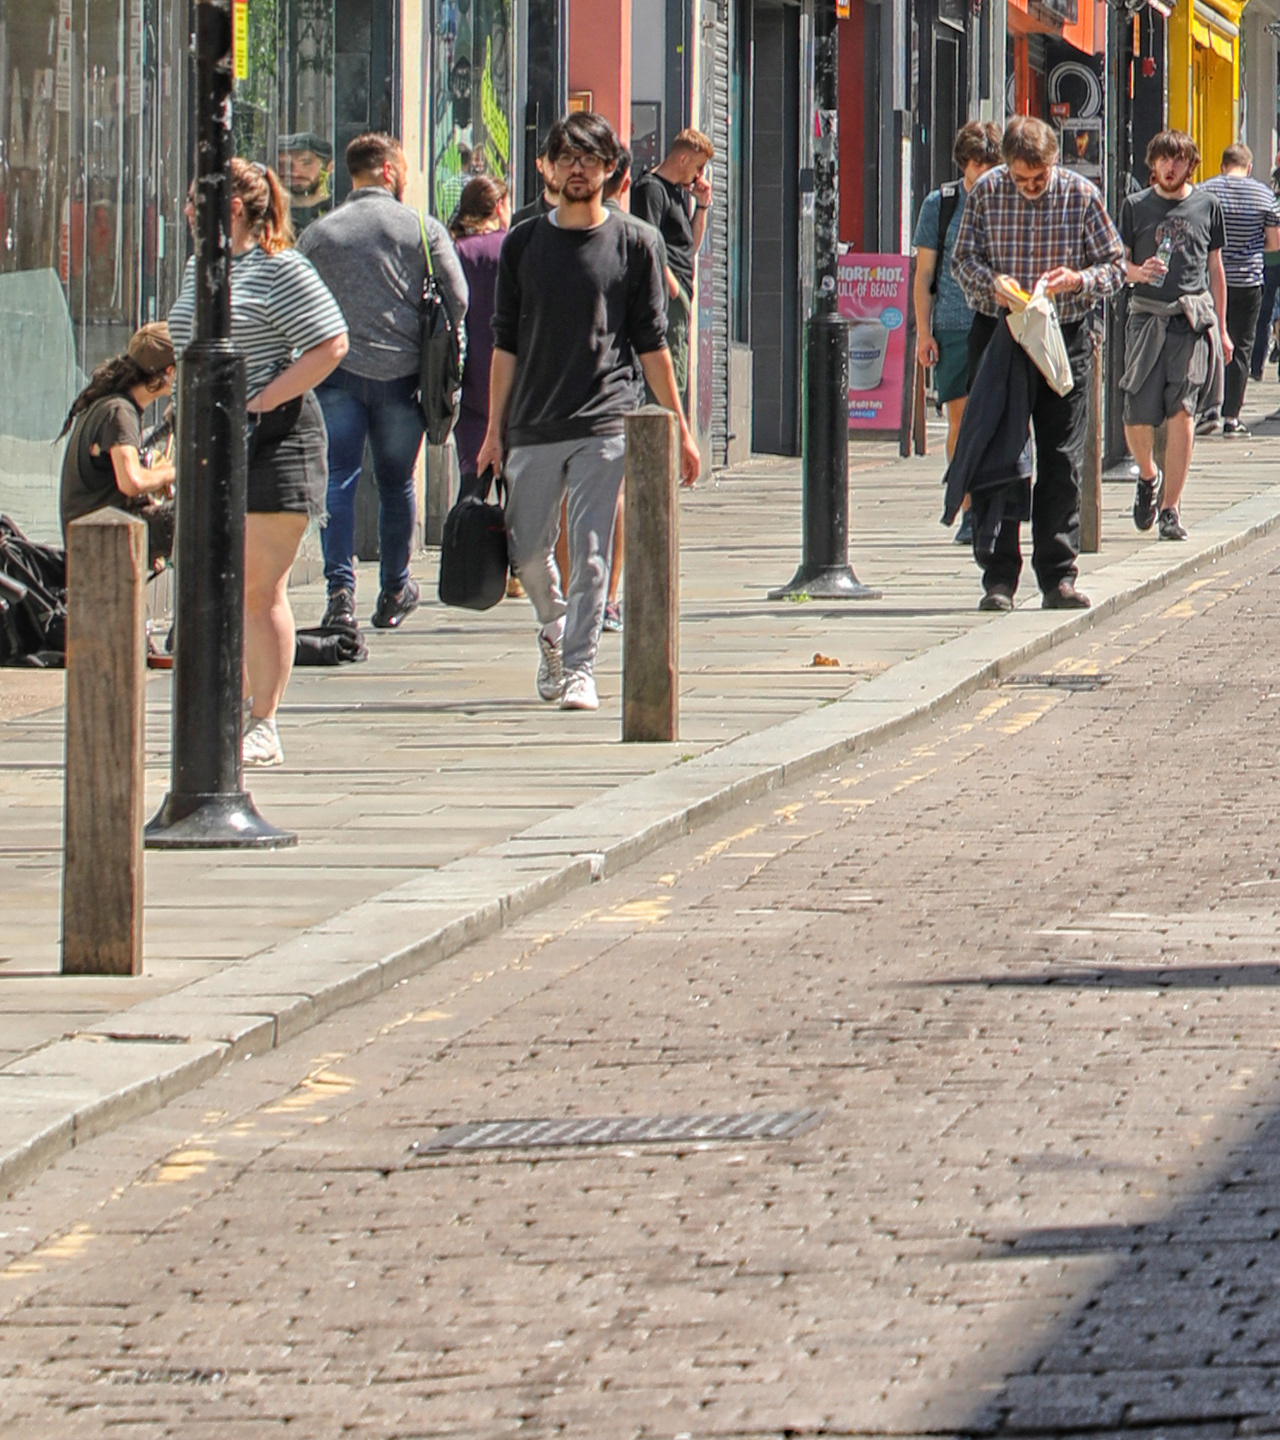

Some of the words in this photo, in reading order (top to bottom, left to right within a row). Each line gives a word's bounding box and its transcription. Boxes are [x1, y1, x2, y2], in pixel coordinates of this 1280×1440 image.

[837, 266, 873, 281] HORT.
[876, 267, 904, 282] HOT.
[838, 283, 853, 297] ULL
[856, 283, 867, 297] OF
[870, 283, 898, 298] BEANS
